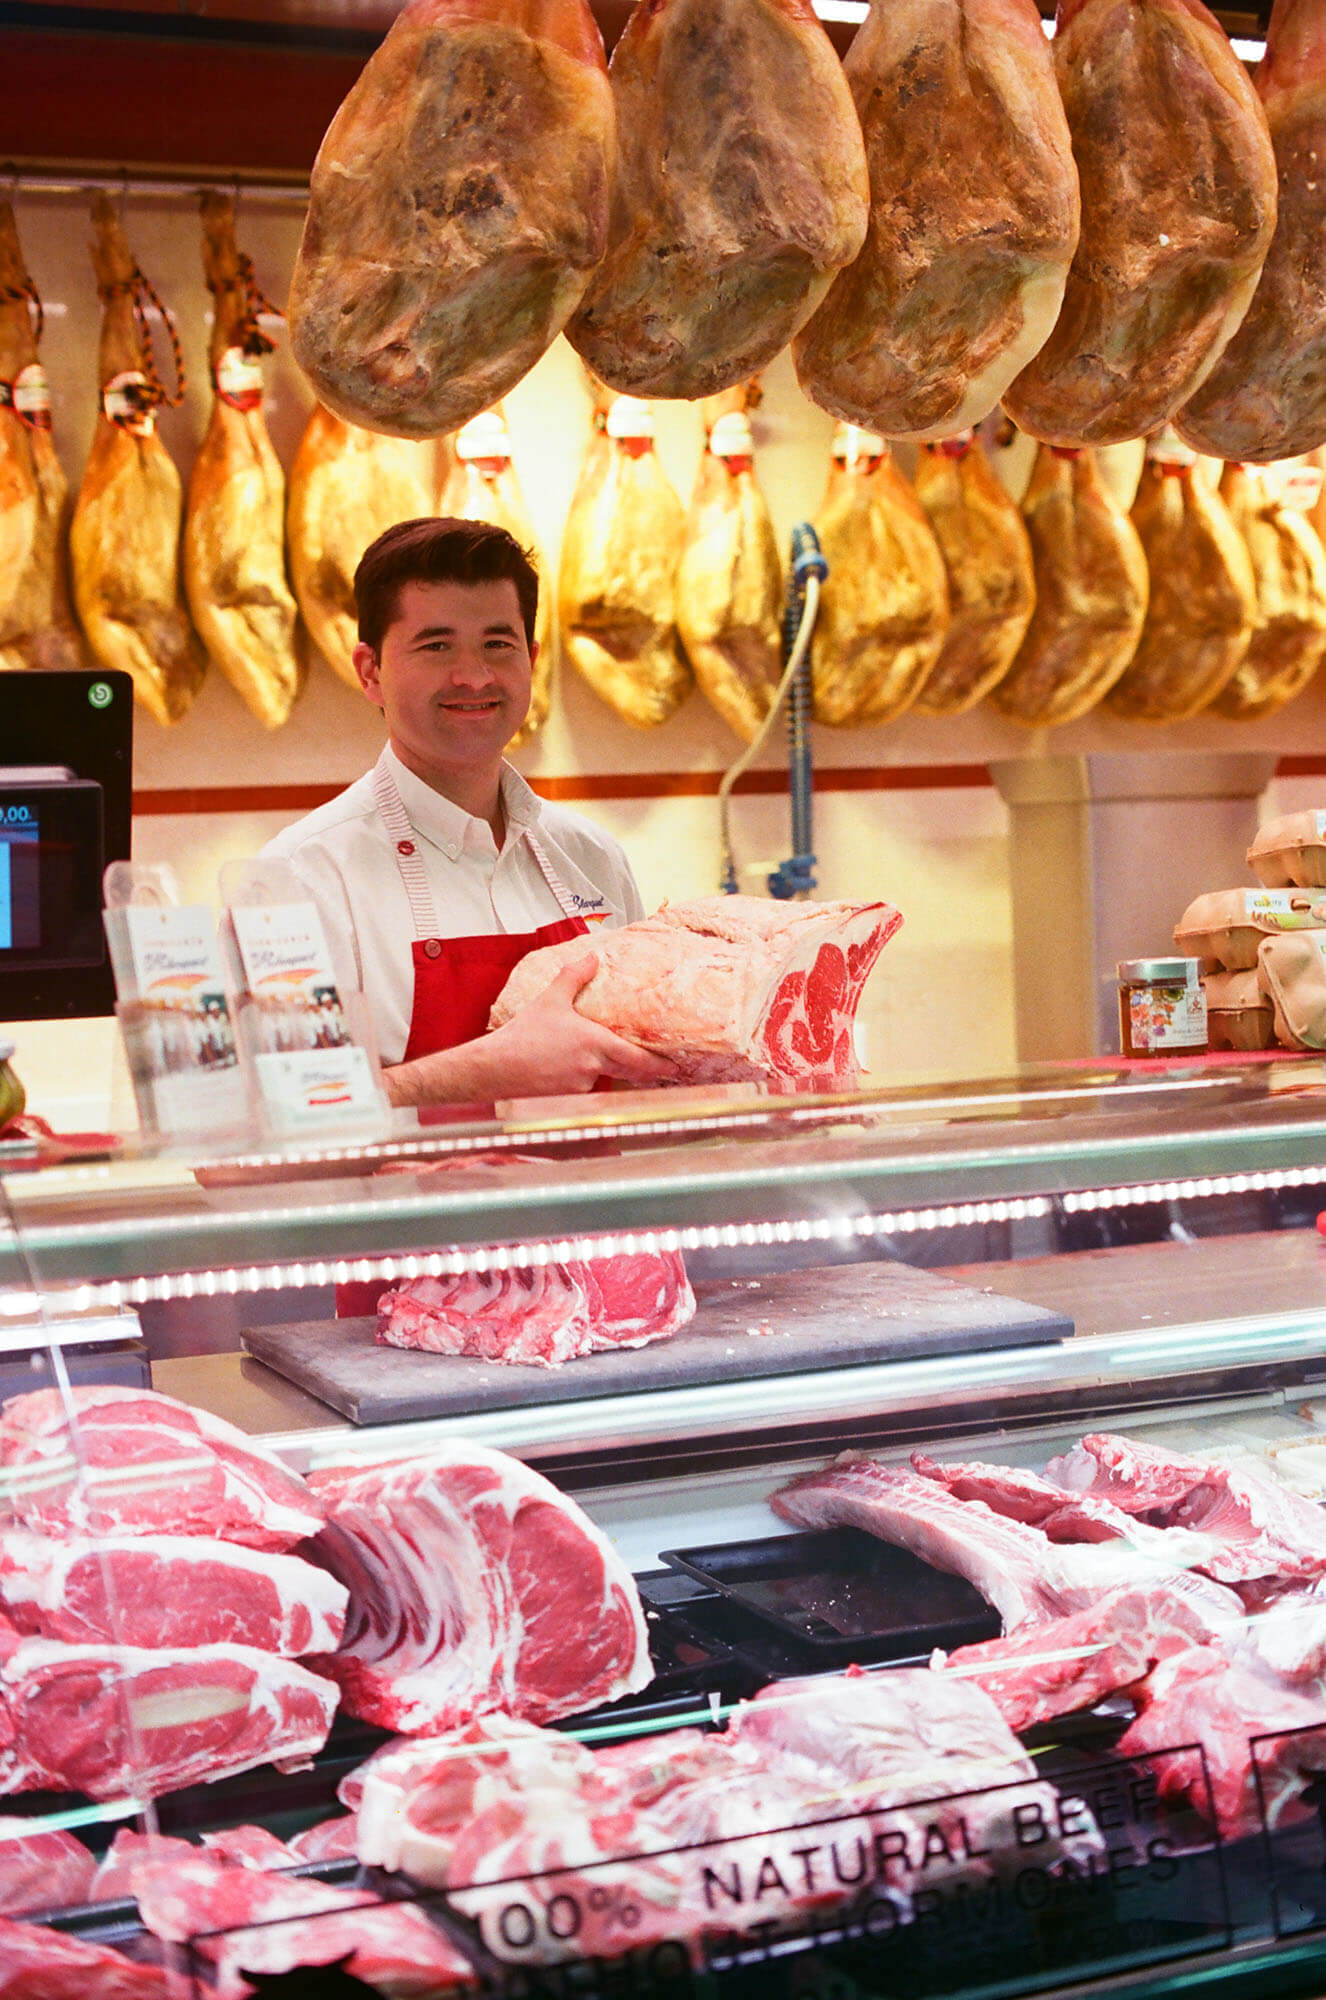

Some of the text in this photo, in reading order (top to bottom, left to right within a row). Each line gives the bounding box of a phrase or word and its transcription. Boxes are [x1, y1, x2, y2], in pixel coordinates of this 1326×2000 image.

[700, 1819, 992, 1906] NATURAL
[1013, 1778, 1158, 1846] BEEF
[808, 1837, 1182, 1946] HORMONES
